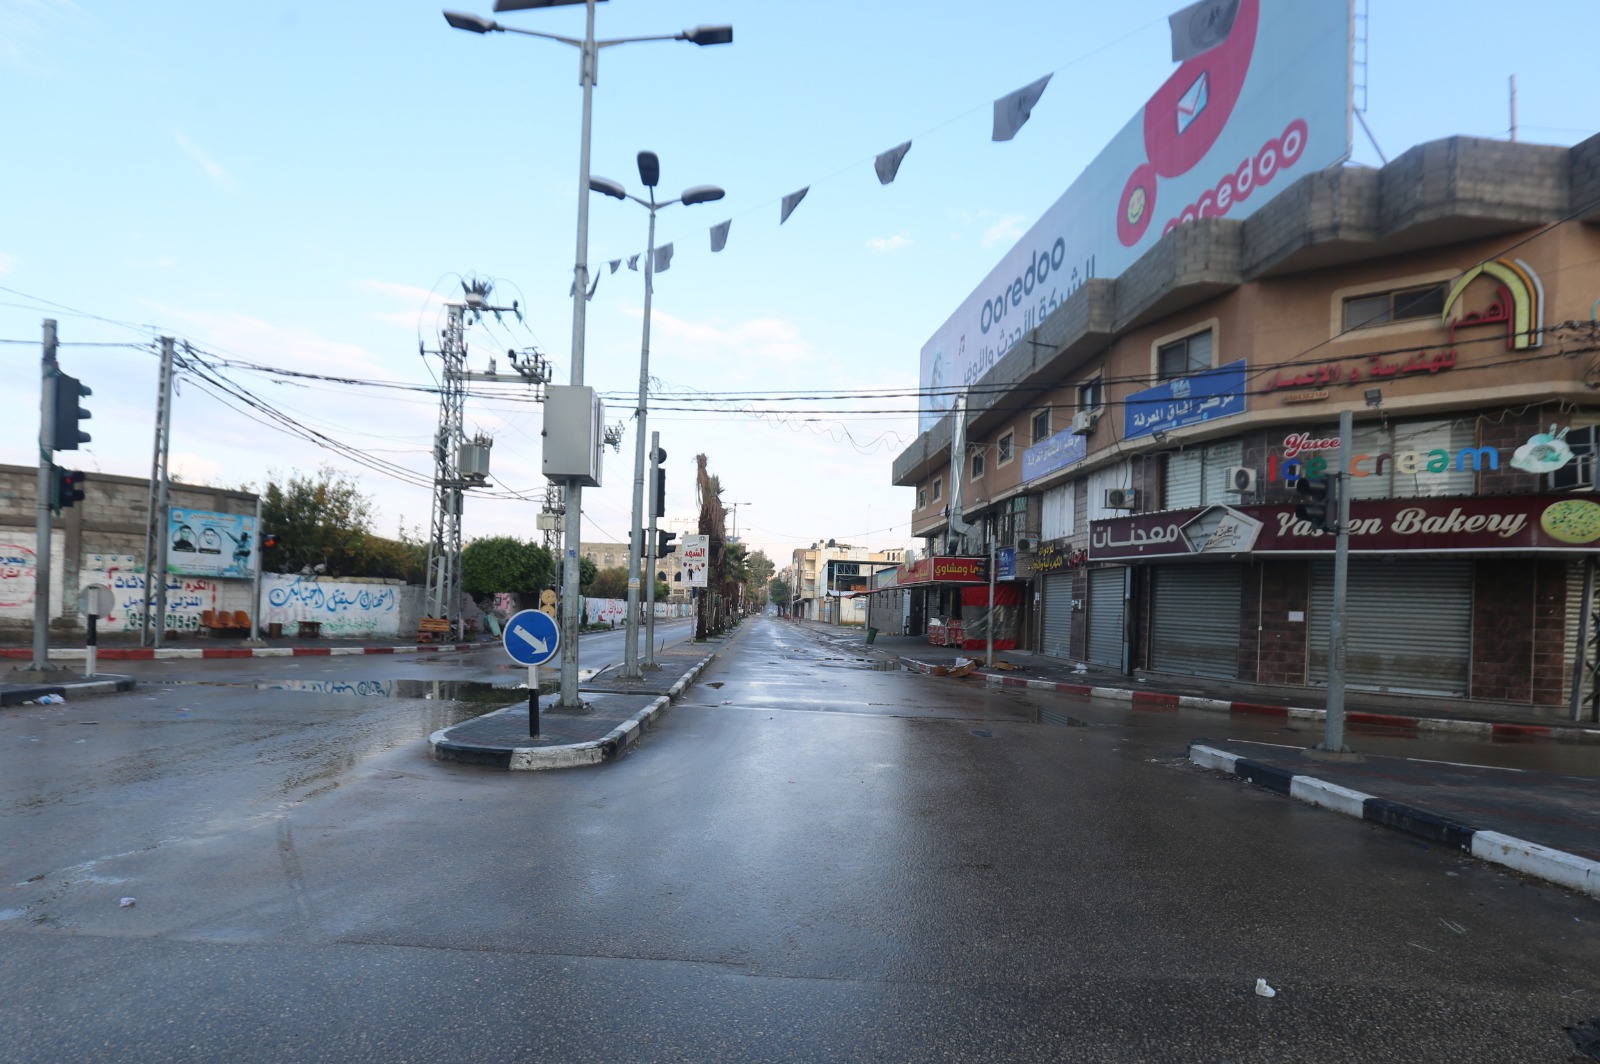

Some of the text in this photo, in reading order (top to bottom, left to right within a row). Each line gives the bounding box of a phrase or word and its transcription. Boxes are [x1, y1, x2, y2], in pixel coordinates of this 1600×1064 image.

[1166, 129, 1302, 233] redoo
[980, 236, 1066, 335] Ooredoo
[1133, 407, 1164, 428] المعرفة
[1284, 432, 1341, 458] Yasee
[1268, 448, 1499, 483] Ice cream
[1390, 507, 1529, 538] Bakery
[934, 562, 968, 577] ومشاوي
